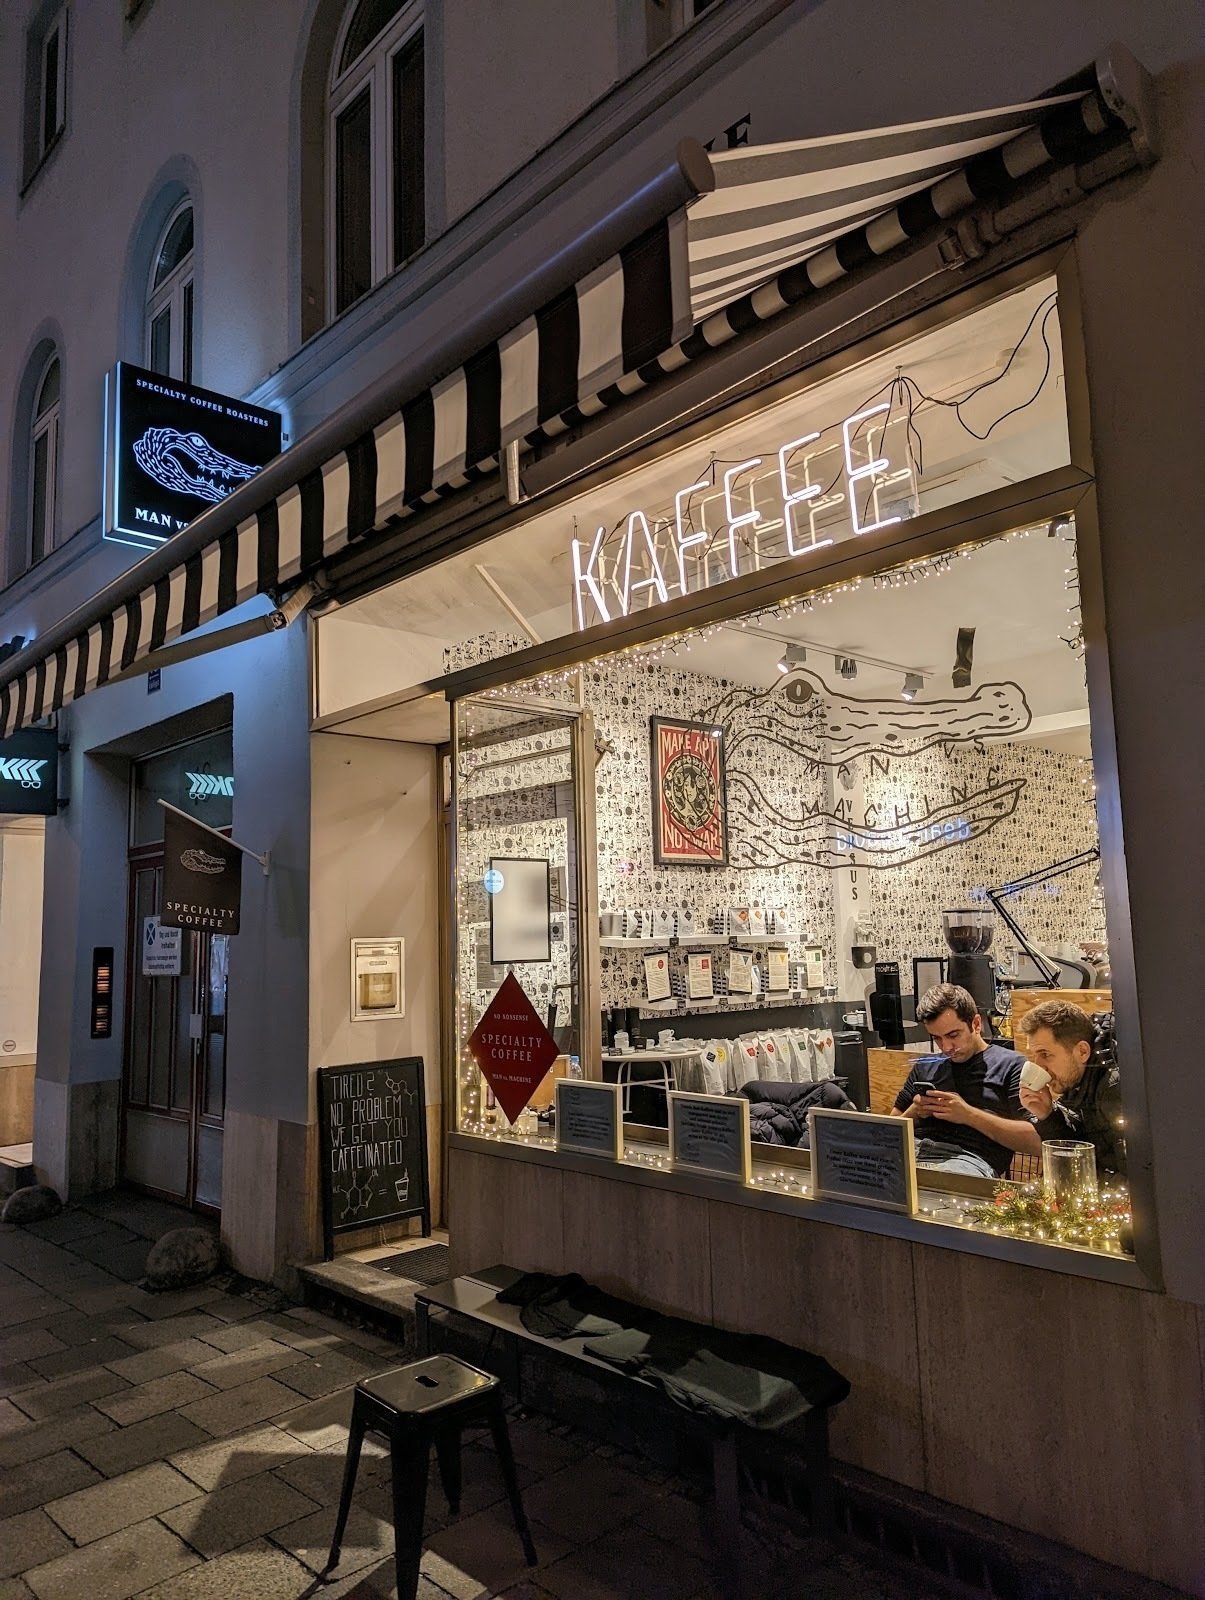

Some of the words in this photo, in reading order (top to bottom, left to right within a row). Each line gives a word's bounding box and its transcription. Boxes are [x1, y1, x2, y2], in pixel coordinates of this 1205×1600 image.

[136, 379, 187, 400] SPECIALTY
[190, 396, 223, 413] COFFEE
[226, 408, 269, 427] ROASTERS
[134, 506, 171, 529] MAN
[572, 403, 902, 631] KAFFEE
[661, 731, 691, 769] MAKE
[804, 754, 890, 779] MAN
[664, 811, 690, 849] NOT
[166, 901, 235, 918] SPECIALTY
[177, 914, 223, 928] COFFEE
[481, 1033, 542, 1048] SPECIALTY
[491, 1048, 532, 1062] COFFEE
[330, 1102, 344, 1128] NO
[352, 1095, 402, 1124] PROBLEM
[330, 1126, 347, 1148] WE
[351, 1121, 377, 1145] GET
[384, 1116, 409, 1140] YOU
[331, 1139, 403, 1173] CAFFEINATED
